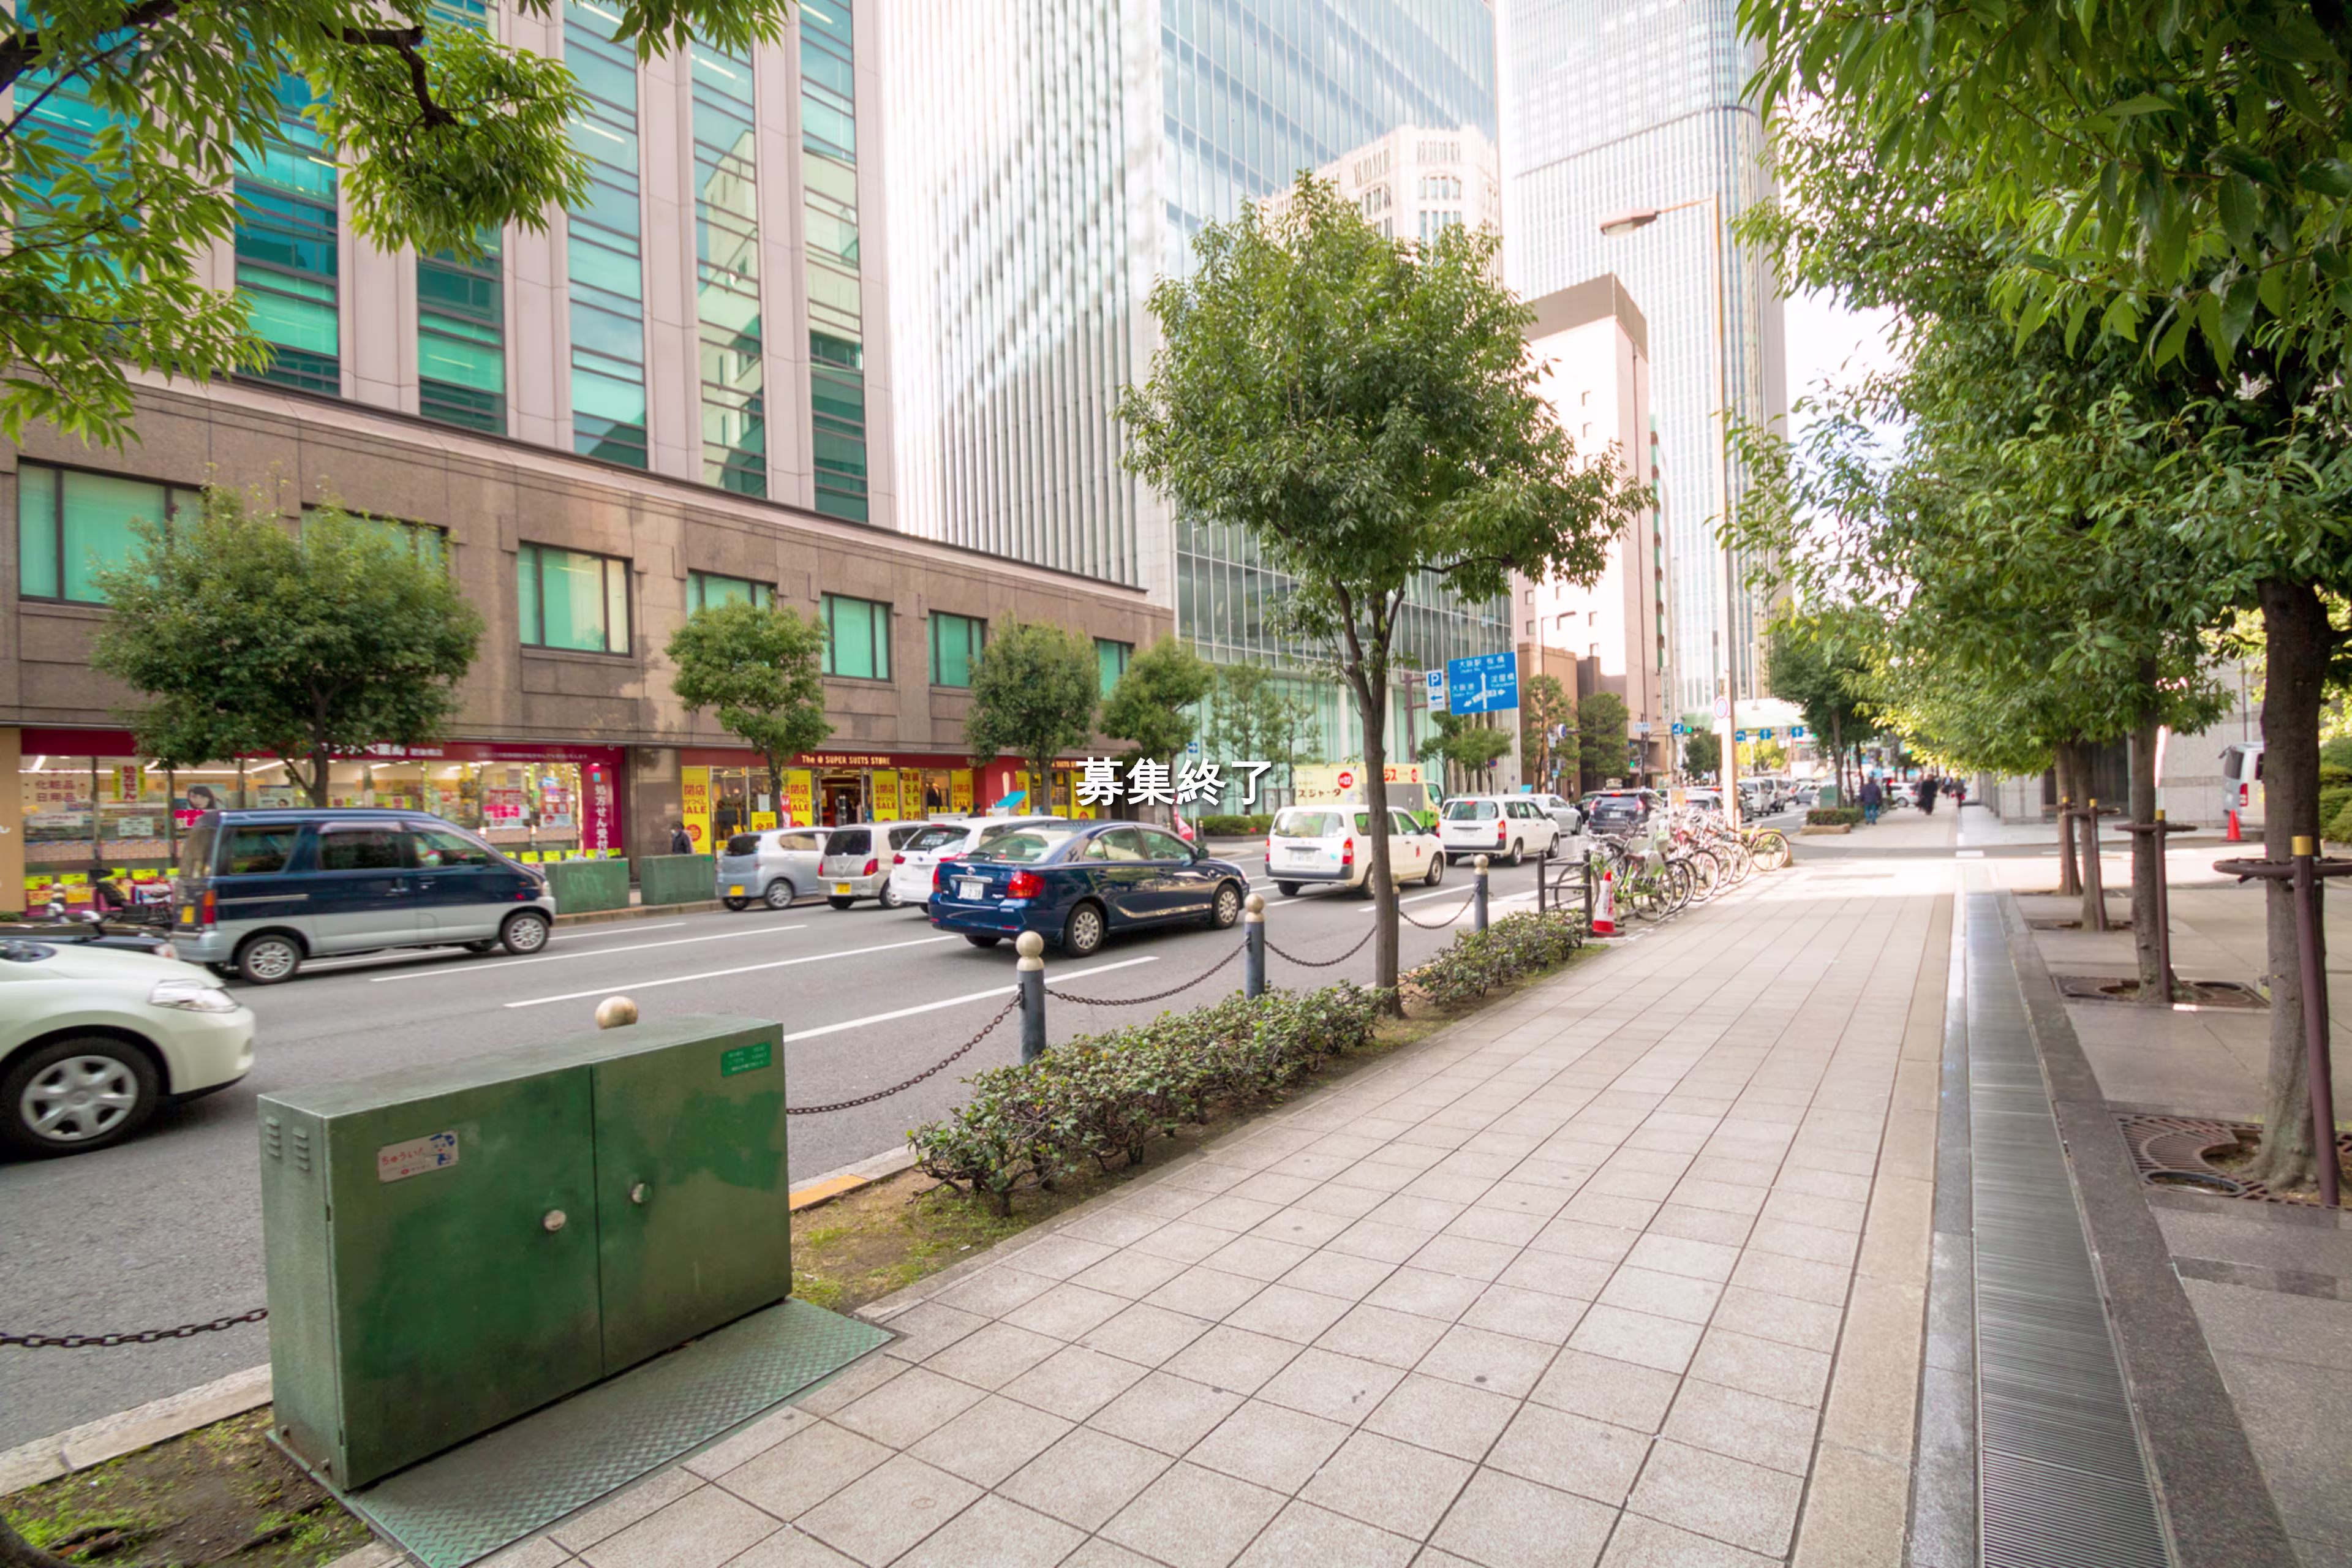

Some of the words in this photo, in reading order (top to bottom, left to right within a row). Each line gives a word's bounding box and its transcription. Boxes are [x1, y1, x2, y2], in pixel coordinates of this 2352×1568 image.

[1432, 674, 1439, 686] P
[684, 784, 706, 796] 閉店
[790, 784, 809, 795] 閉店
[1298, 788, 1341, 797] スジャータ
